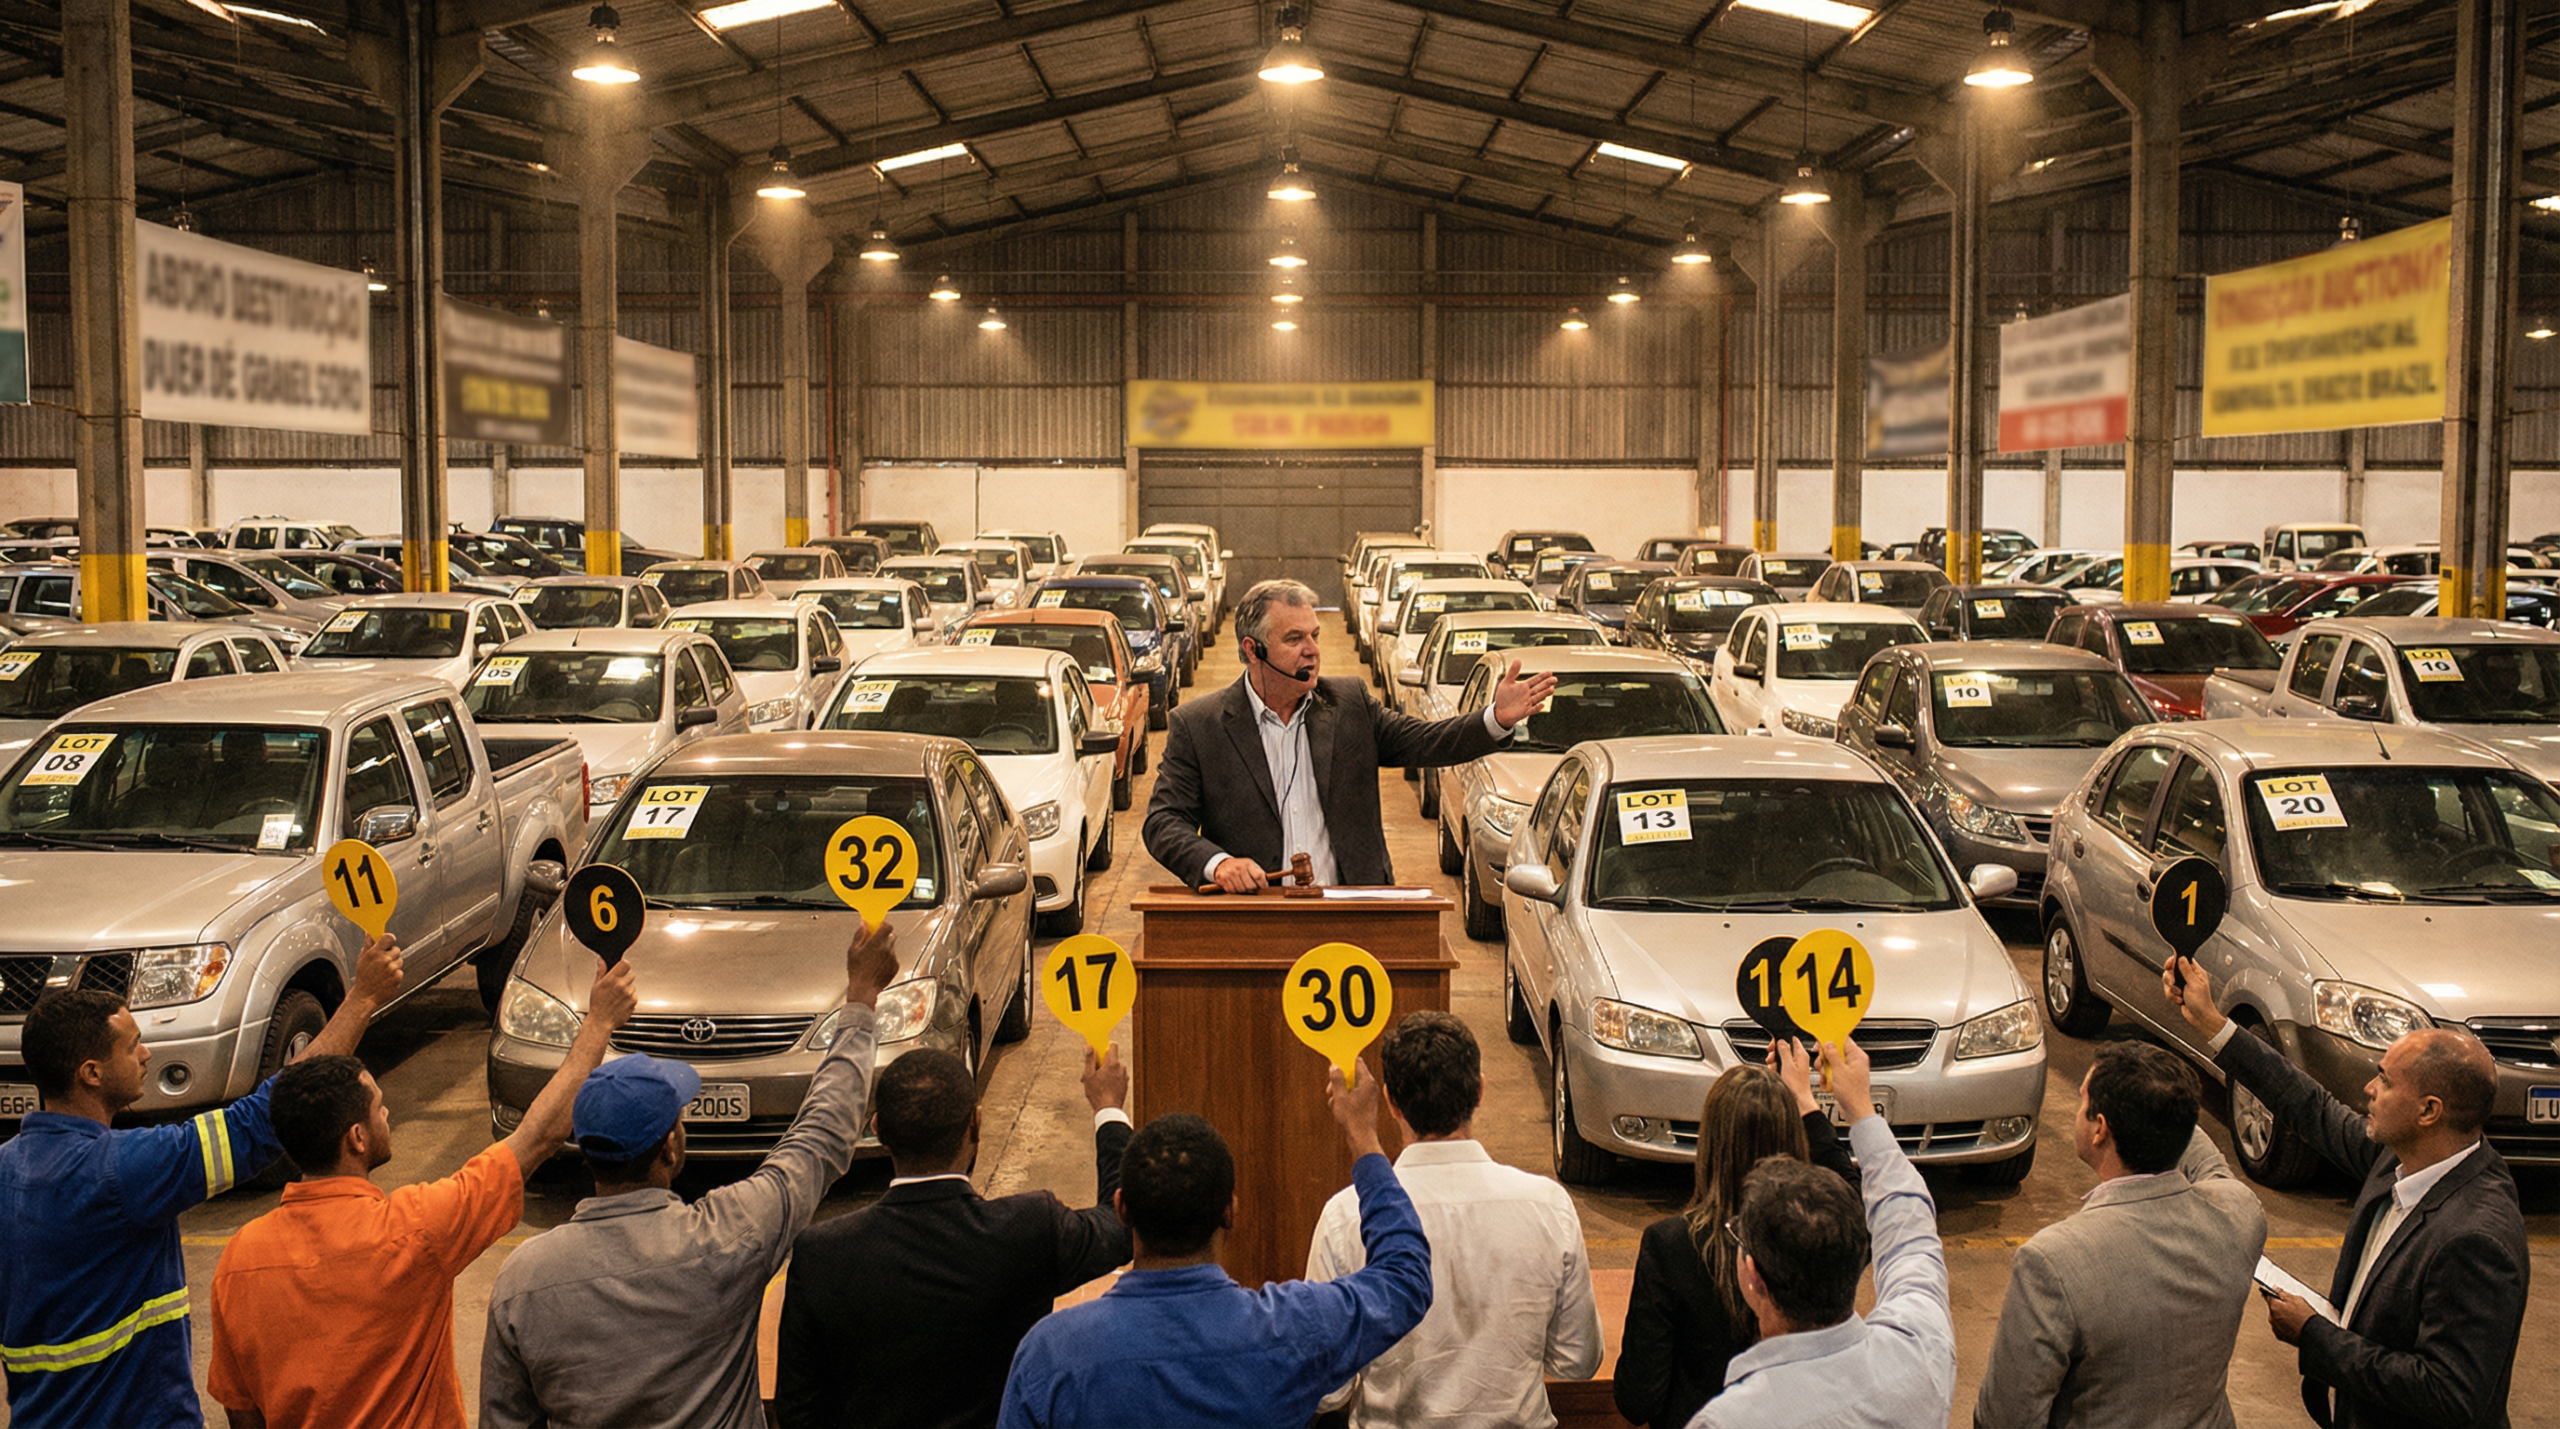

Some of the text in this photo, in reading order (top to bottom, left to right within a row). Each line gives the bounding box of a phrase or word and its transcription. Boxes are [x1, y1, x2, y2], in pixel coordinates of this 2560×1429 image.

[487, 668, 511, 678] 05
[855, 692, 882, 702] 02
[1954, 687, 1980, 698] 10
[58, 738, 106, 749] LOT
[44, 754, 85, 771] 08
[648, 790, 698, 802] LOT
[2268, 781, 2318, 794] LOT
[1626, 793, 1677, 808] LOT
[2280, 796, 2325, 815] 20
[645, 807, 686, 825] 17
[1633, 810, 1676, 829] 13
[839, 834, 904, 890] 32
[334, 855, 383, 908] 11
[590, 884, 618, 932] 6
[2181, 881, 2198, 925] 1
[1055, 951, 1117, 1012] 17
[1750, 958, 1785, 1007] 1
[1796, 947, 1861, 1014] 14
[1299, 964, 1376, 1032] 30
